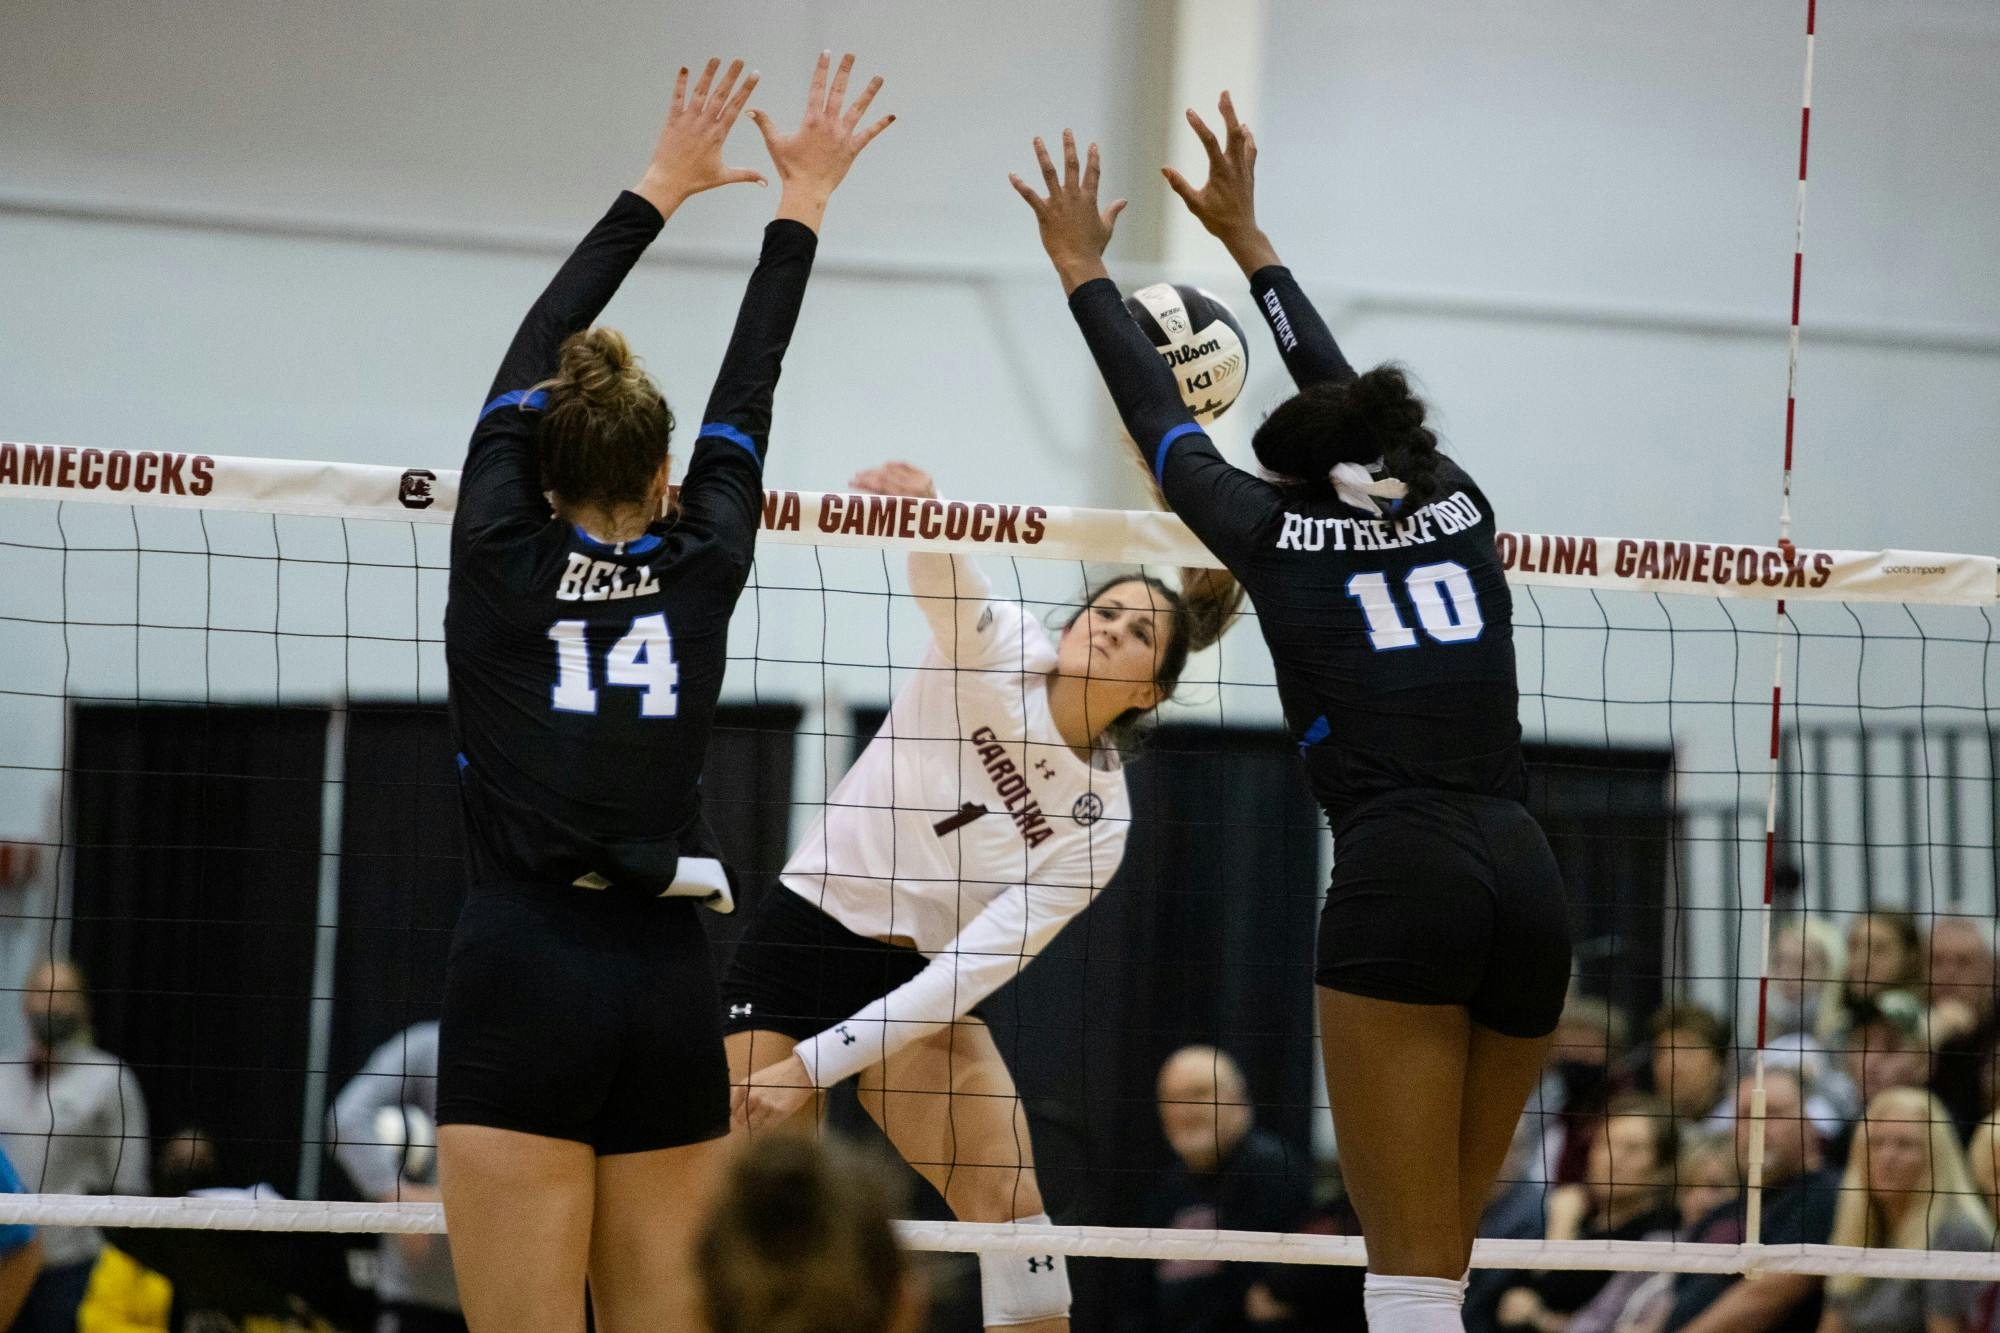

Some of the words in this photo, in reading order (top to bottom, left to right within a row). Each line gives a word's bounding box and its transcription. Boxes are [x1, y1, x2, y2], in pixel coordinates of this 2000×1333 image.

[1263, 288, 1298, 352] KENTUCKY
[0, 443, 215, 496] AMECOCKS
[818, 493, 1047, 544] GAMECOCKS
[1276, 491, 1482, 551] RUTHERFORD
[556, 552, 661, 601] BELL
[1614, 539, 1834, 588] GAMECOCKS
[1344, 560, 1485, 653] 10
[546, 611, 681, 719] 14
[971, 726, 1054, 849] CAROLINA
[933, 801, 988, 837] 1
